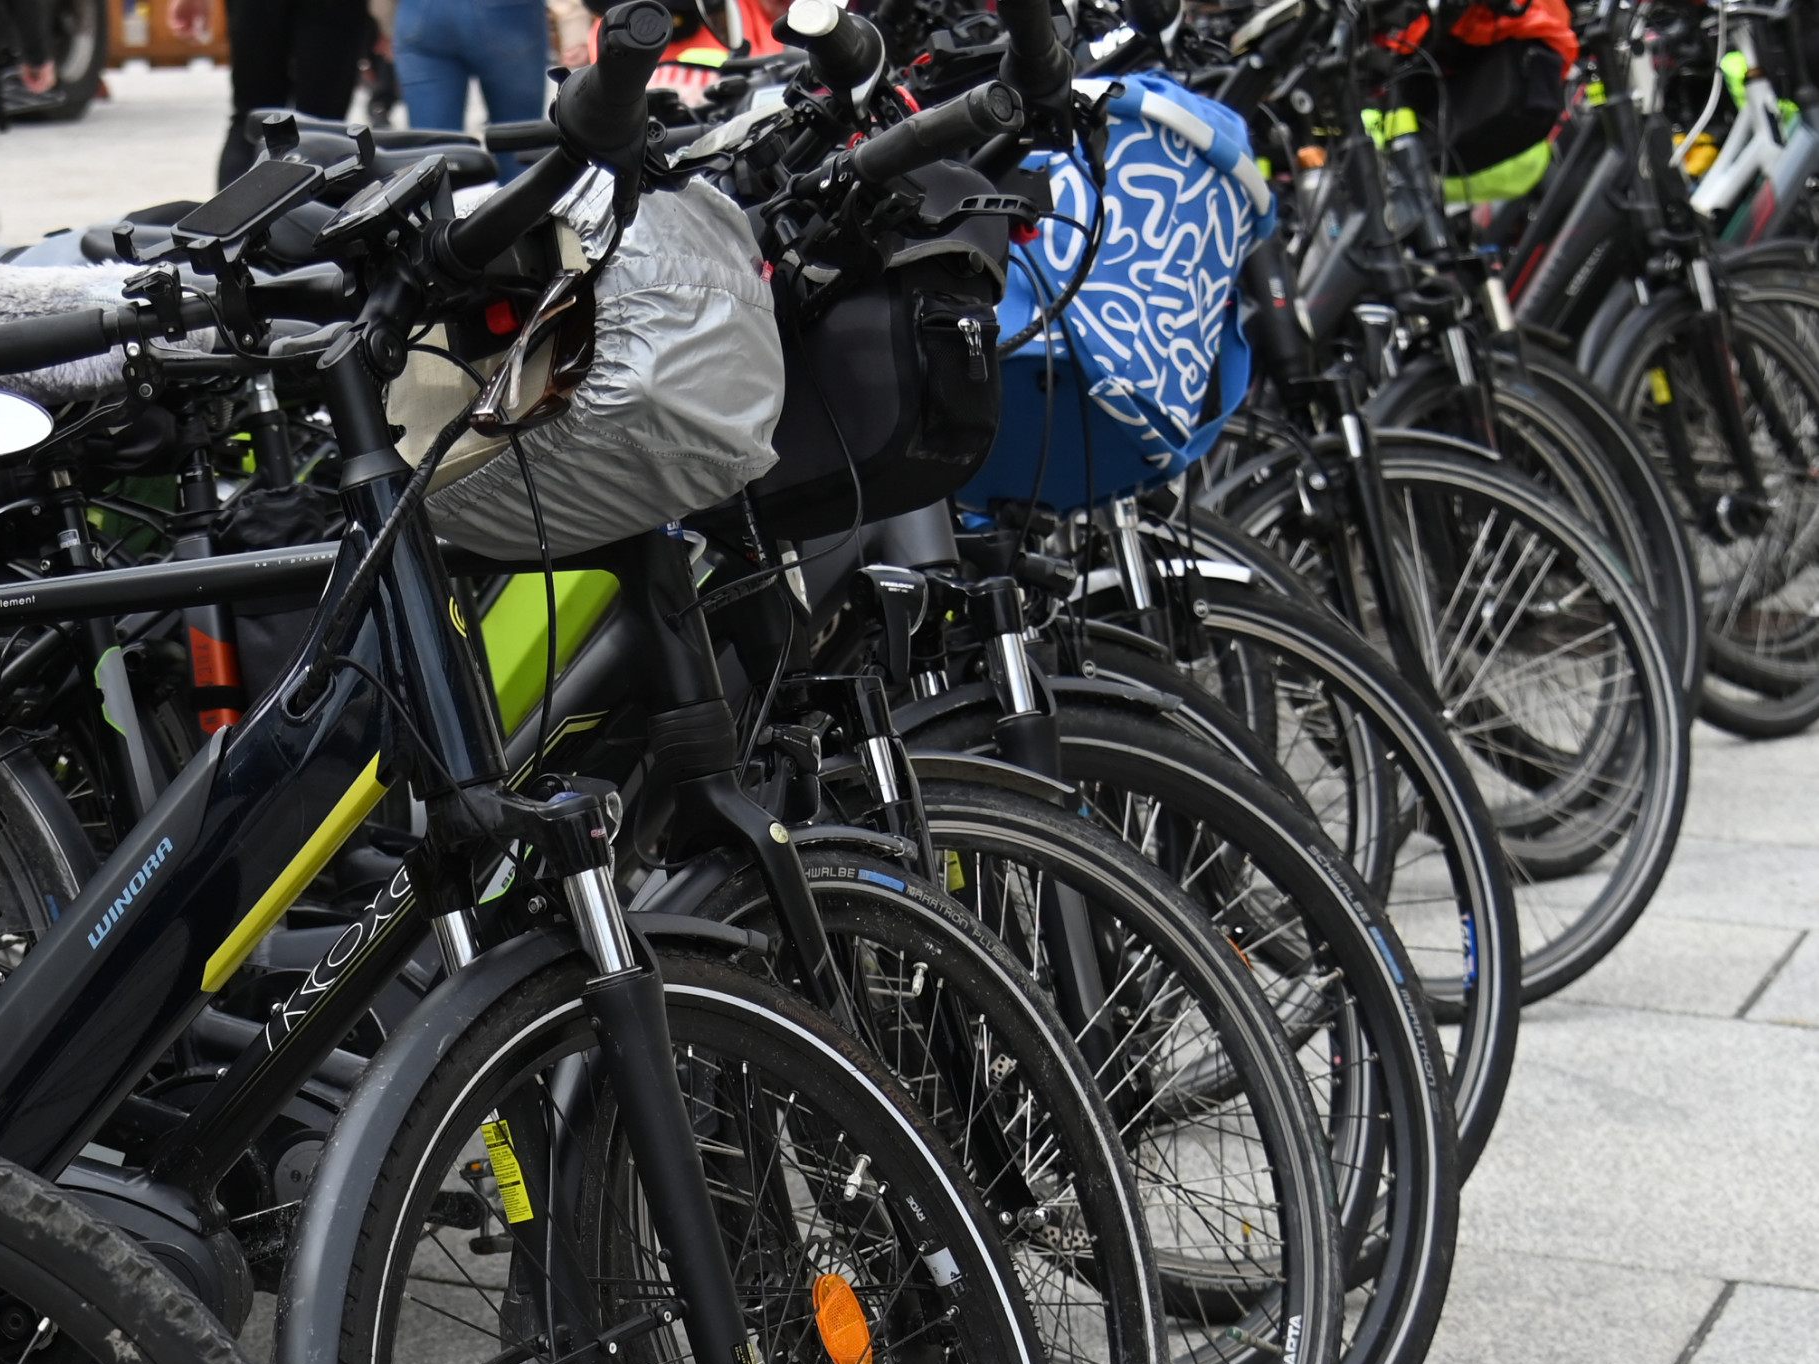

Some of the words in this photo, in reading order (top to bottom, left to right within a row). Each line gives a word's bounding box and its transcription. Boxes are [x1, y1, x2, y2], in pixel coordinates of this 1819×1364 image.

[803, 867, 856, 879] HWALBE
[1307, 844, 1371, 923] SCHWALBE
[1400, 988, 1437, 1087] MARATHON
